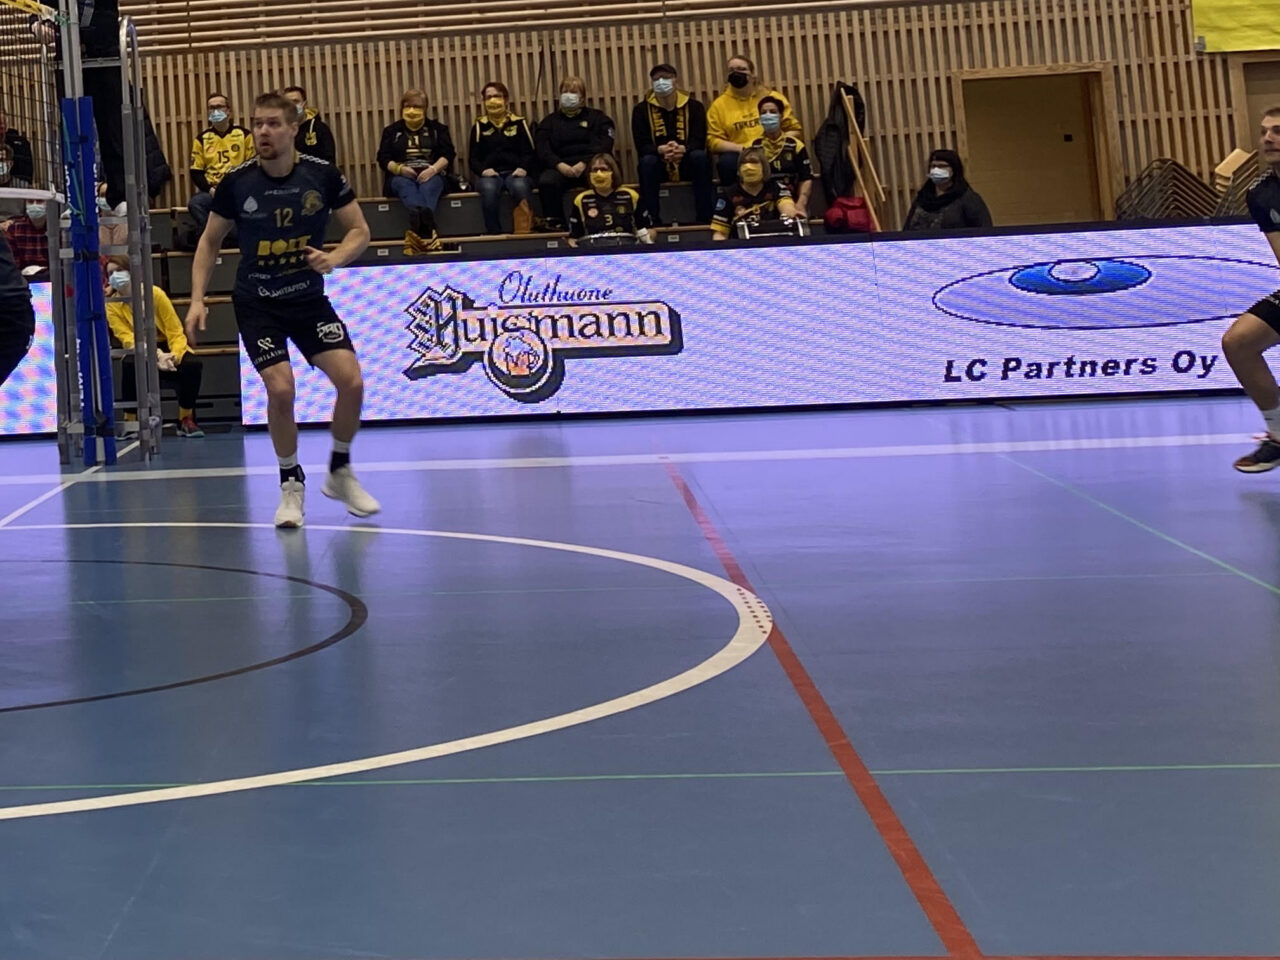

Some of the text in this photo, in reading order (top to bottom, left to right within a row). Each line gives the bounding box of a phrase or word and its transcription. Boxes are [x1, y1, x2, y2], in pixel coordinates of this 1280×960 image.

[217, 150, 230, 165] 15
[274, 208, 293, 227] 12
[604, 214, 613, 225] 3
[498, 270, 613, 304] Oluthuone
[942, 349, 1218, 383] LC Partners Oy
